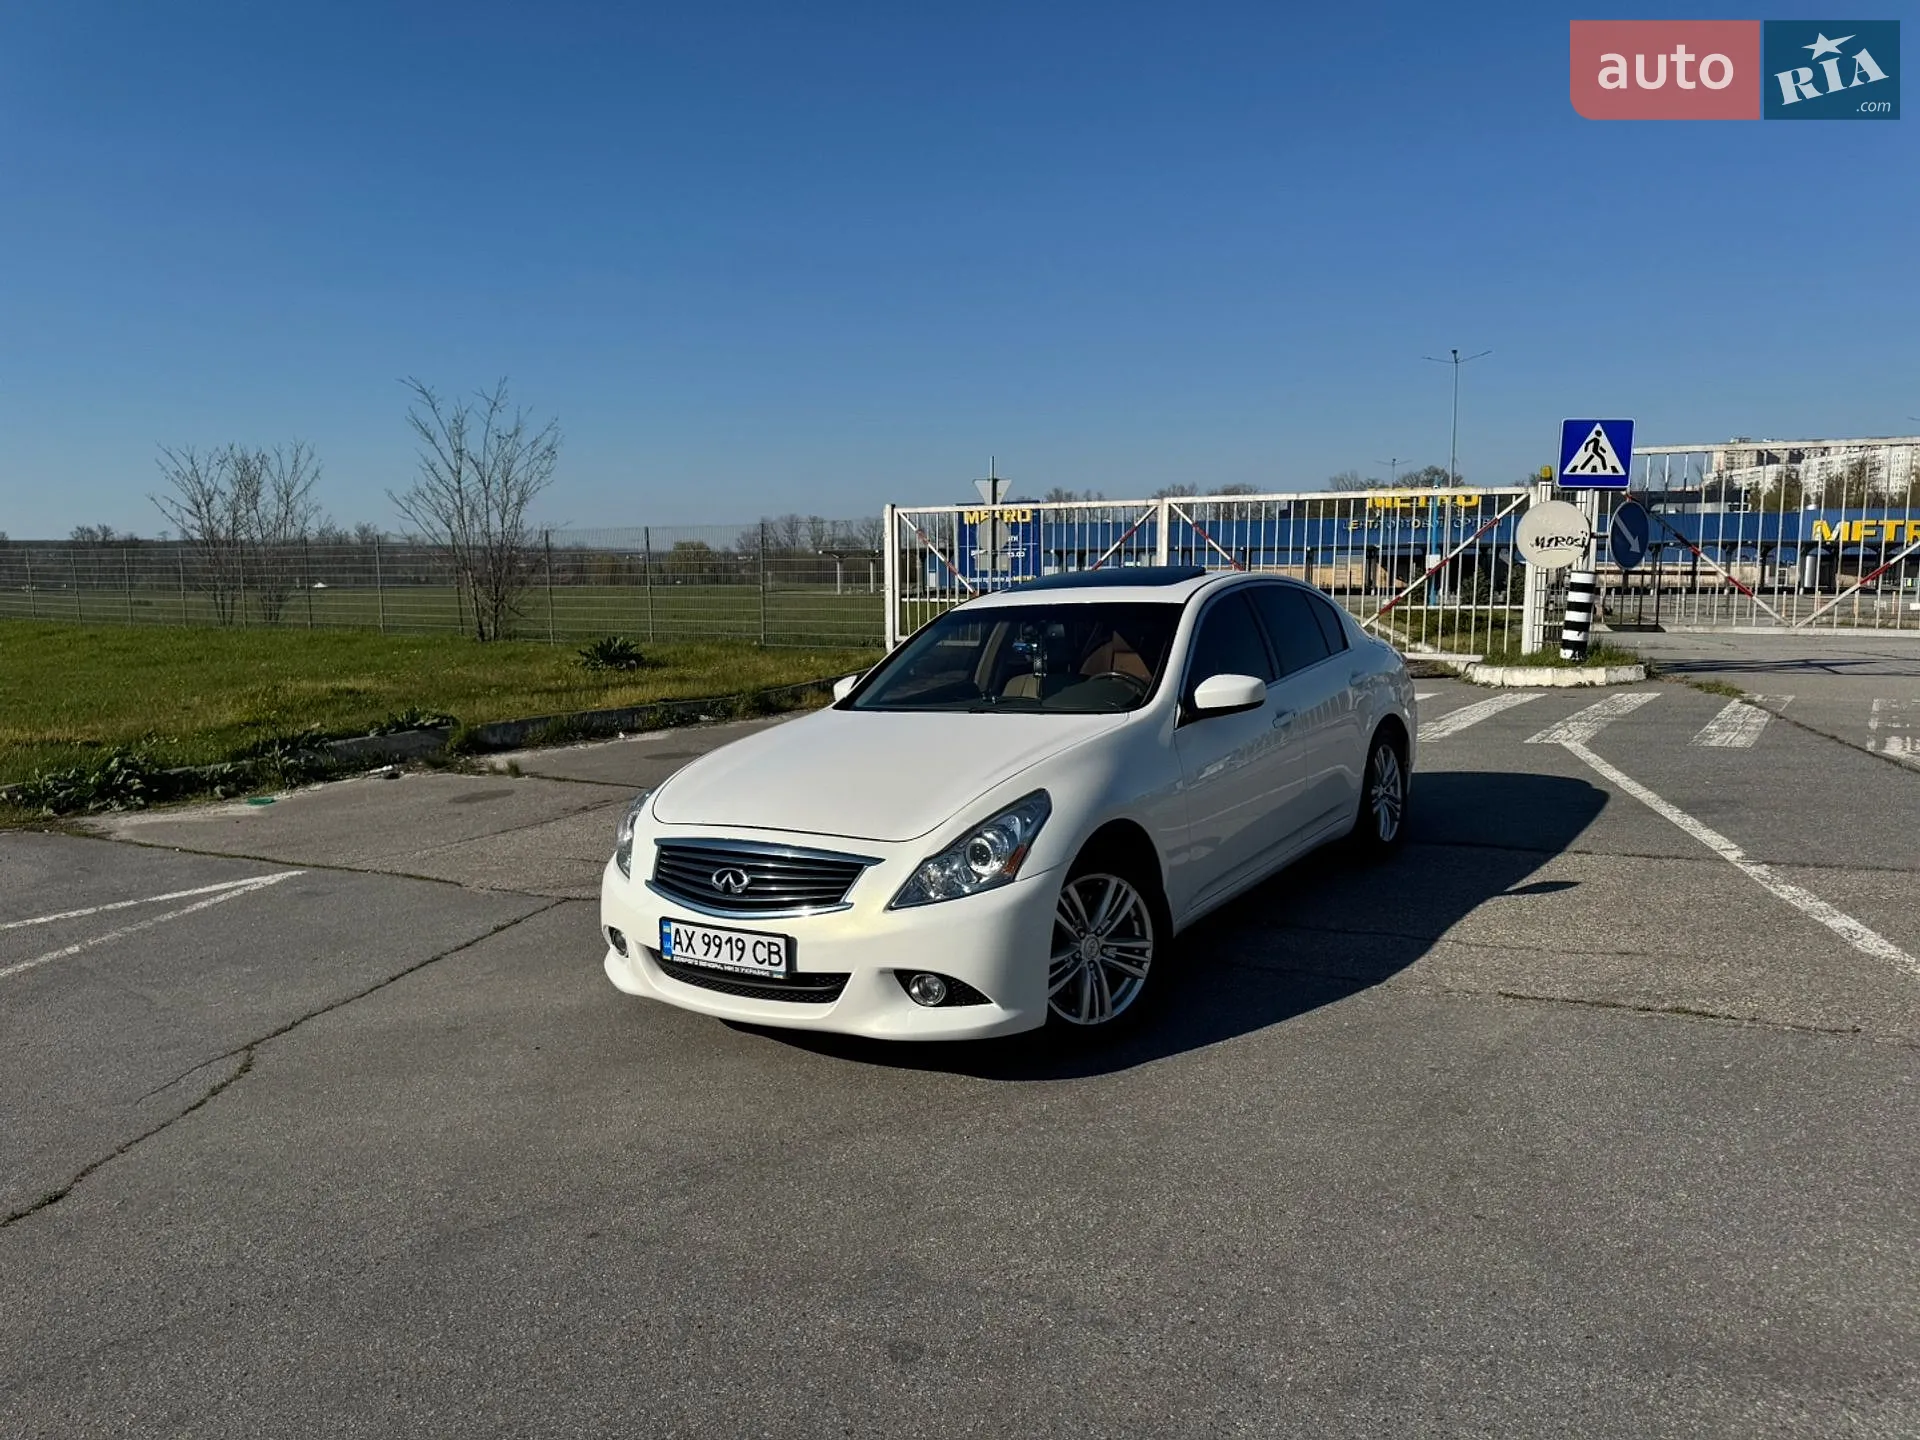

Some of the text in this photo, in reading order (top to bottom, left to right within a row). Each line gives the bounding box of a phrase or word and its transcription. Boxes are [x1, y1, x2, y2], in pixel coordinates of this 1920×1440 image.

[673, 928, 783, 967] AX 9919 CB
